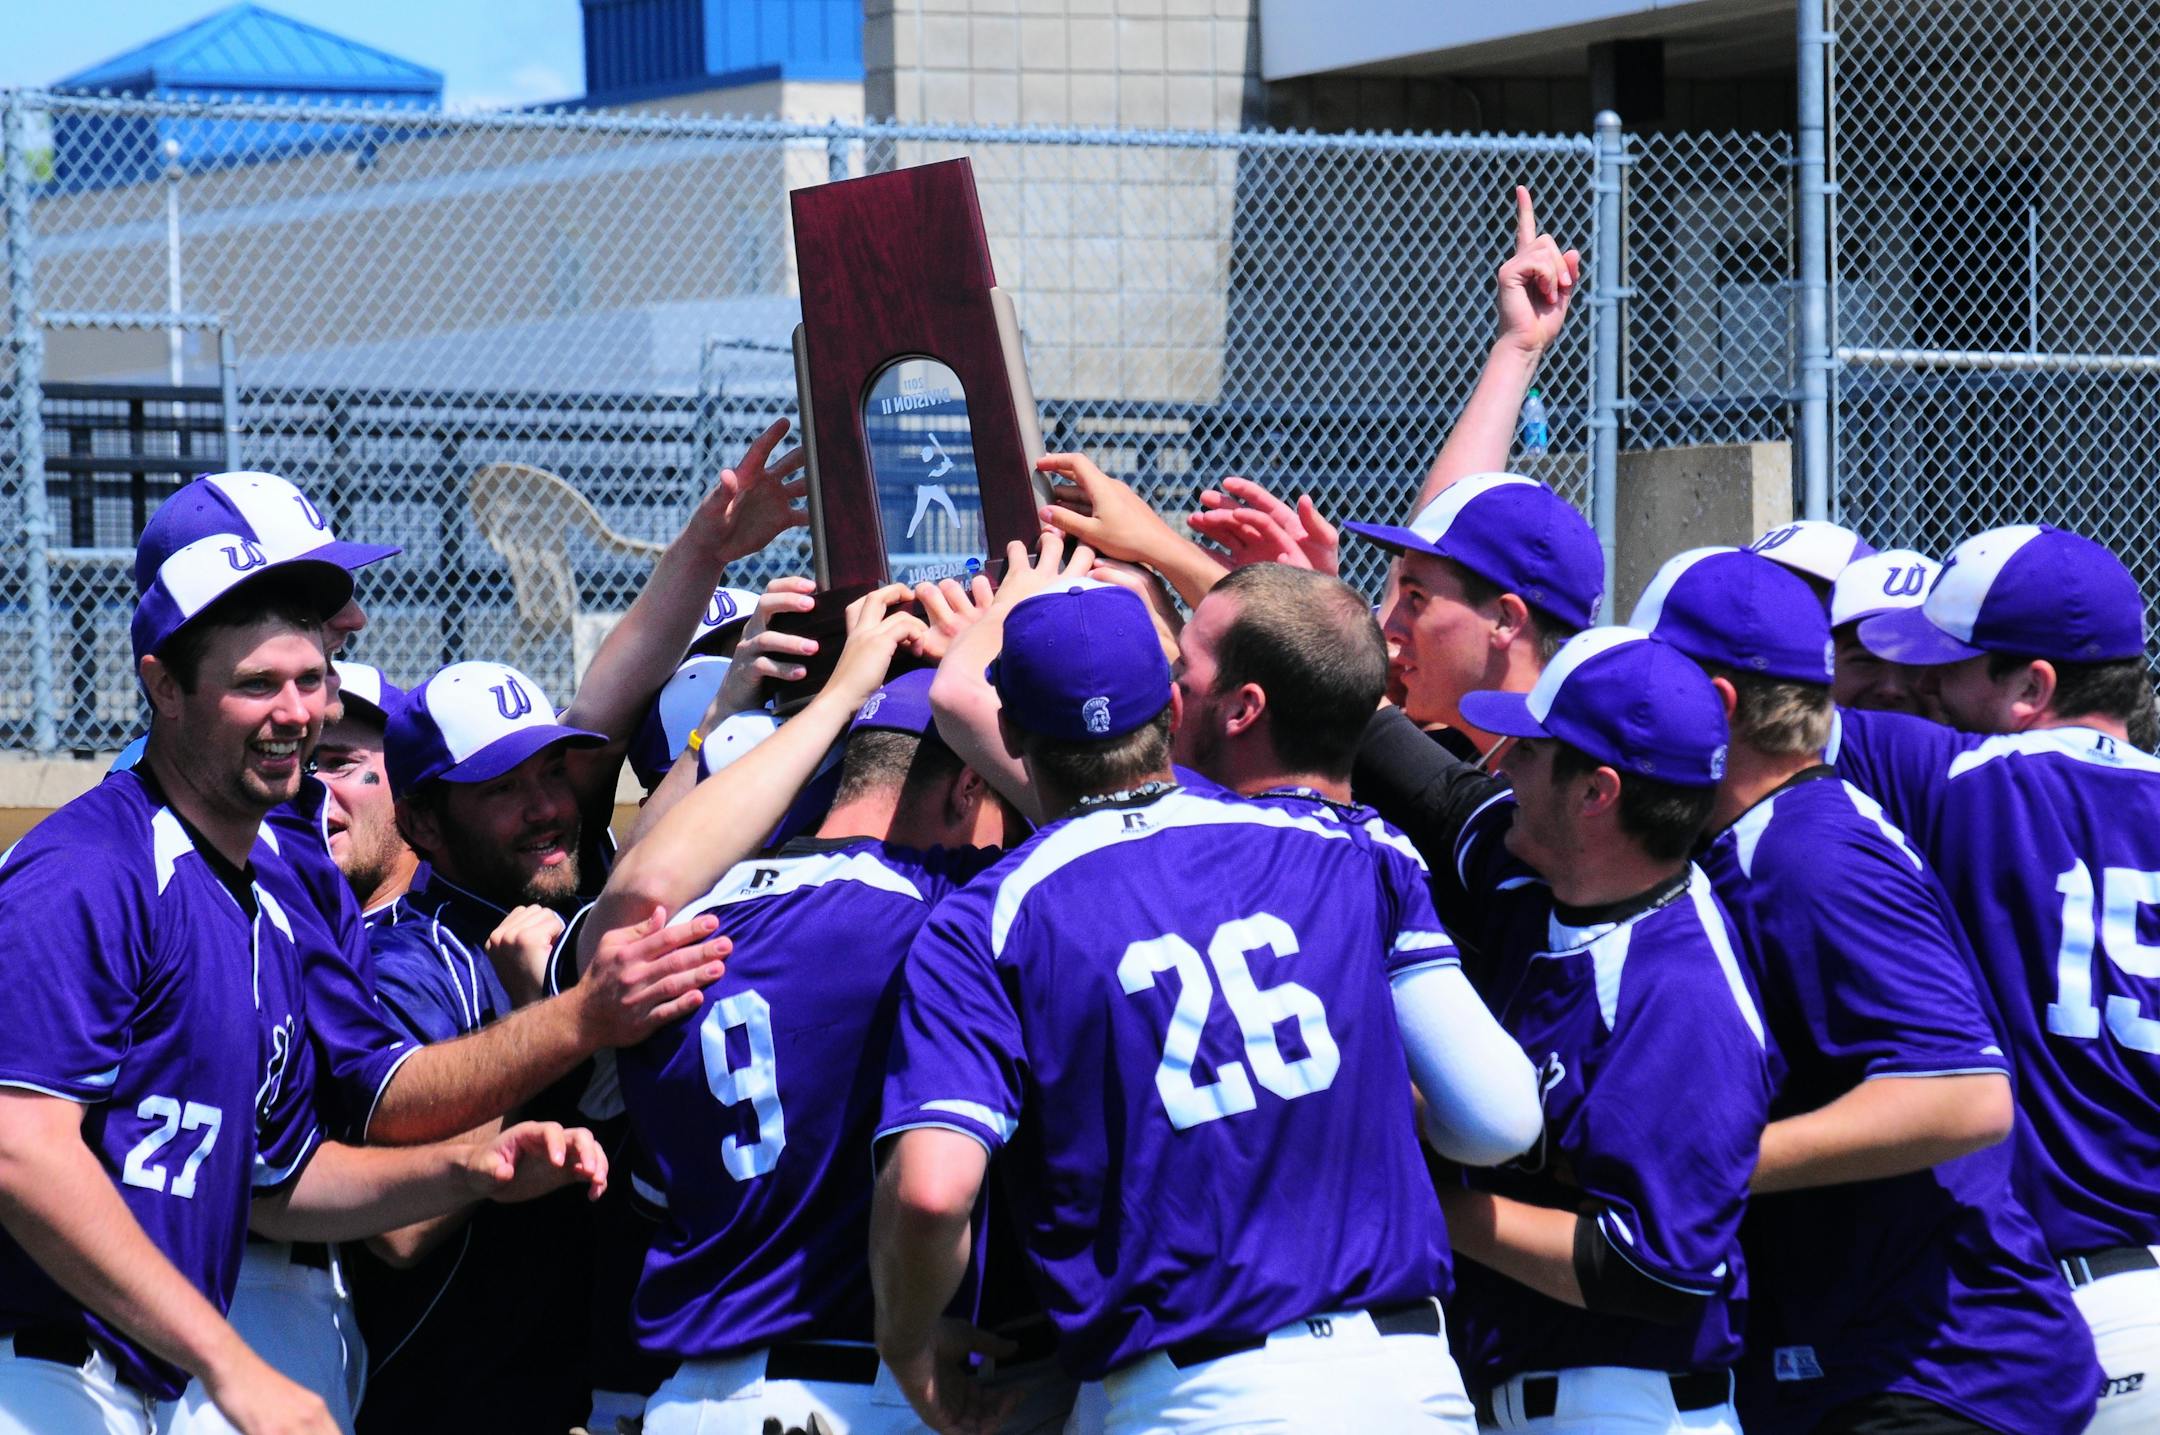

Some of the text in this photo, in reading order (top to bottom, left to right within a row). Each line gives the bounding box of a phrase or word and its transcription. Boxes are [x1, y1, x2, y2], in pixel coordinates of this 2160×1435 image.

[1883, 563, 1927, 597] W
[488, 674, 532, 720] W
[1116, 911, 1341, 1131] 26
[2046, 857, 2160, 1057] 15
[122, 1094, 223, 1200] 27
[700, 988, 787, 1182] 9
